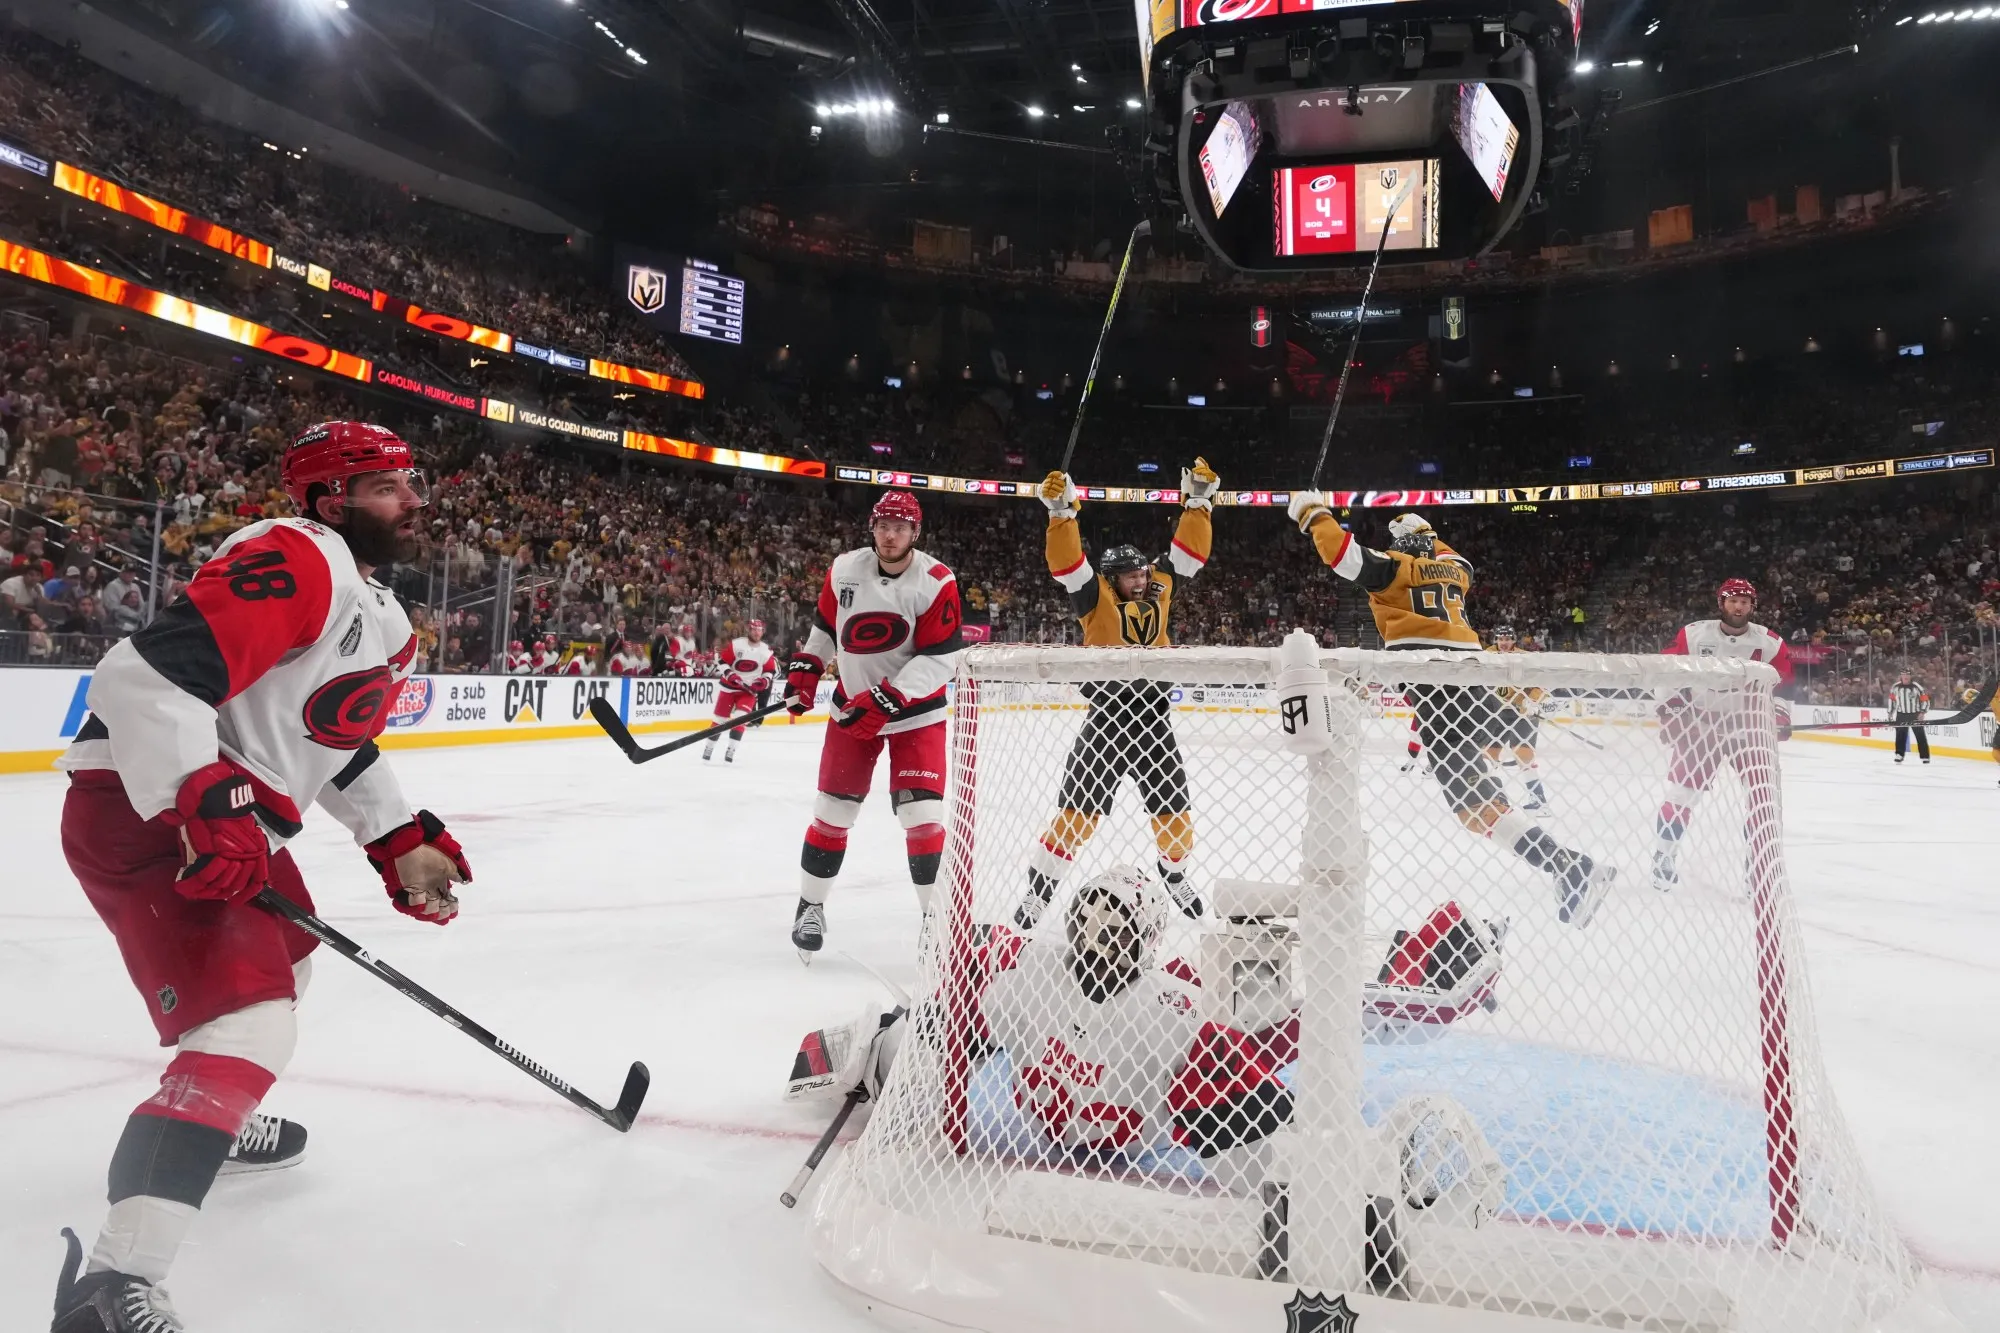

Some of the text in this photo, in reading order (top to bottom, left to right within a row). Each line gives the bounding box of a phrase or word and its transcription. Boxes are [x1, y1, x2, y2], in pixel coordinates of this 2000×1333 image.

[1299, 93, 1389, 108] ARENA
[1316, 197, 1330, 217] 4
[276, 255, 306, 276] VEGAS
[332, 279, 371, 301] CAROLINA
[1311, 311, 1338, 319] STANLEY
[1340, 310, 1353, 318] CUP
[515, 341, 537, 357] STANLEY
[537, 348, 548, 359] CUP
[555, 353, 572, 366] FINAL
[378, 370, 422, 393] CAROLINA
[424, 385, 475, 410] HURRICANES
[519, 410, 546, 427] VEGAS
[548, 418, 579, 434] GOLDEN
[581, 425, 619, 442] KNIGHTS
[293, 431, 329, 448] Lenovo
[1904, 461, 1931, 470] STANLEY
[1955, 456, 1976, 464] FINAL
[839, 469, 870, 480] 9:22 PM
[1804, 465, 1876, 481] Forged in Gold
[1445, 491, 1471, 500] 14:22
[1653, 481, 1680, 494] RAFFLE
[1418, 563, 1462, 582] MARNER
[789, 660, 812, 669] CM
[451, 681, 486, 699] a sub
[636, 681, 714, 706] BODYARMOR
[504, 678, 548, 722] CAT
[573, 679, 610, 720] CAT
[871, 685, 900, 713] CCM
[446, 702, 486, 721] above
[636, 708, 671, 718] SPORTS DRINK
[899, 769, 940, 781] BAUER
[293, 919, 336, 945] WARRIOR
[400, 987, 421, 1003] ALPHA
[494, 1036, 572, 1094] WARRIOR
[789, 1077, 835, 1094] TRUE
